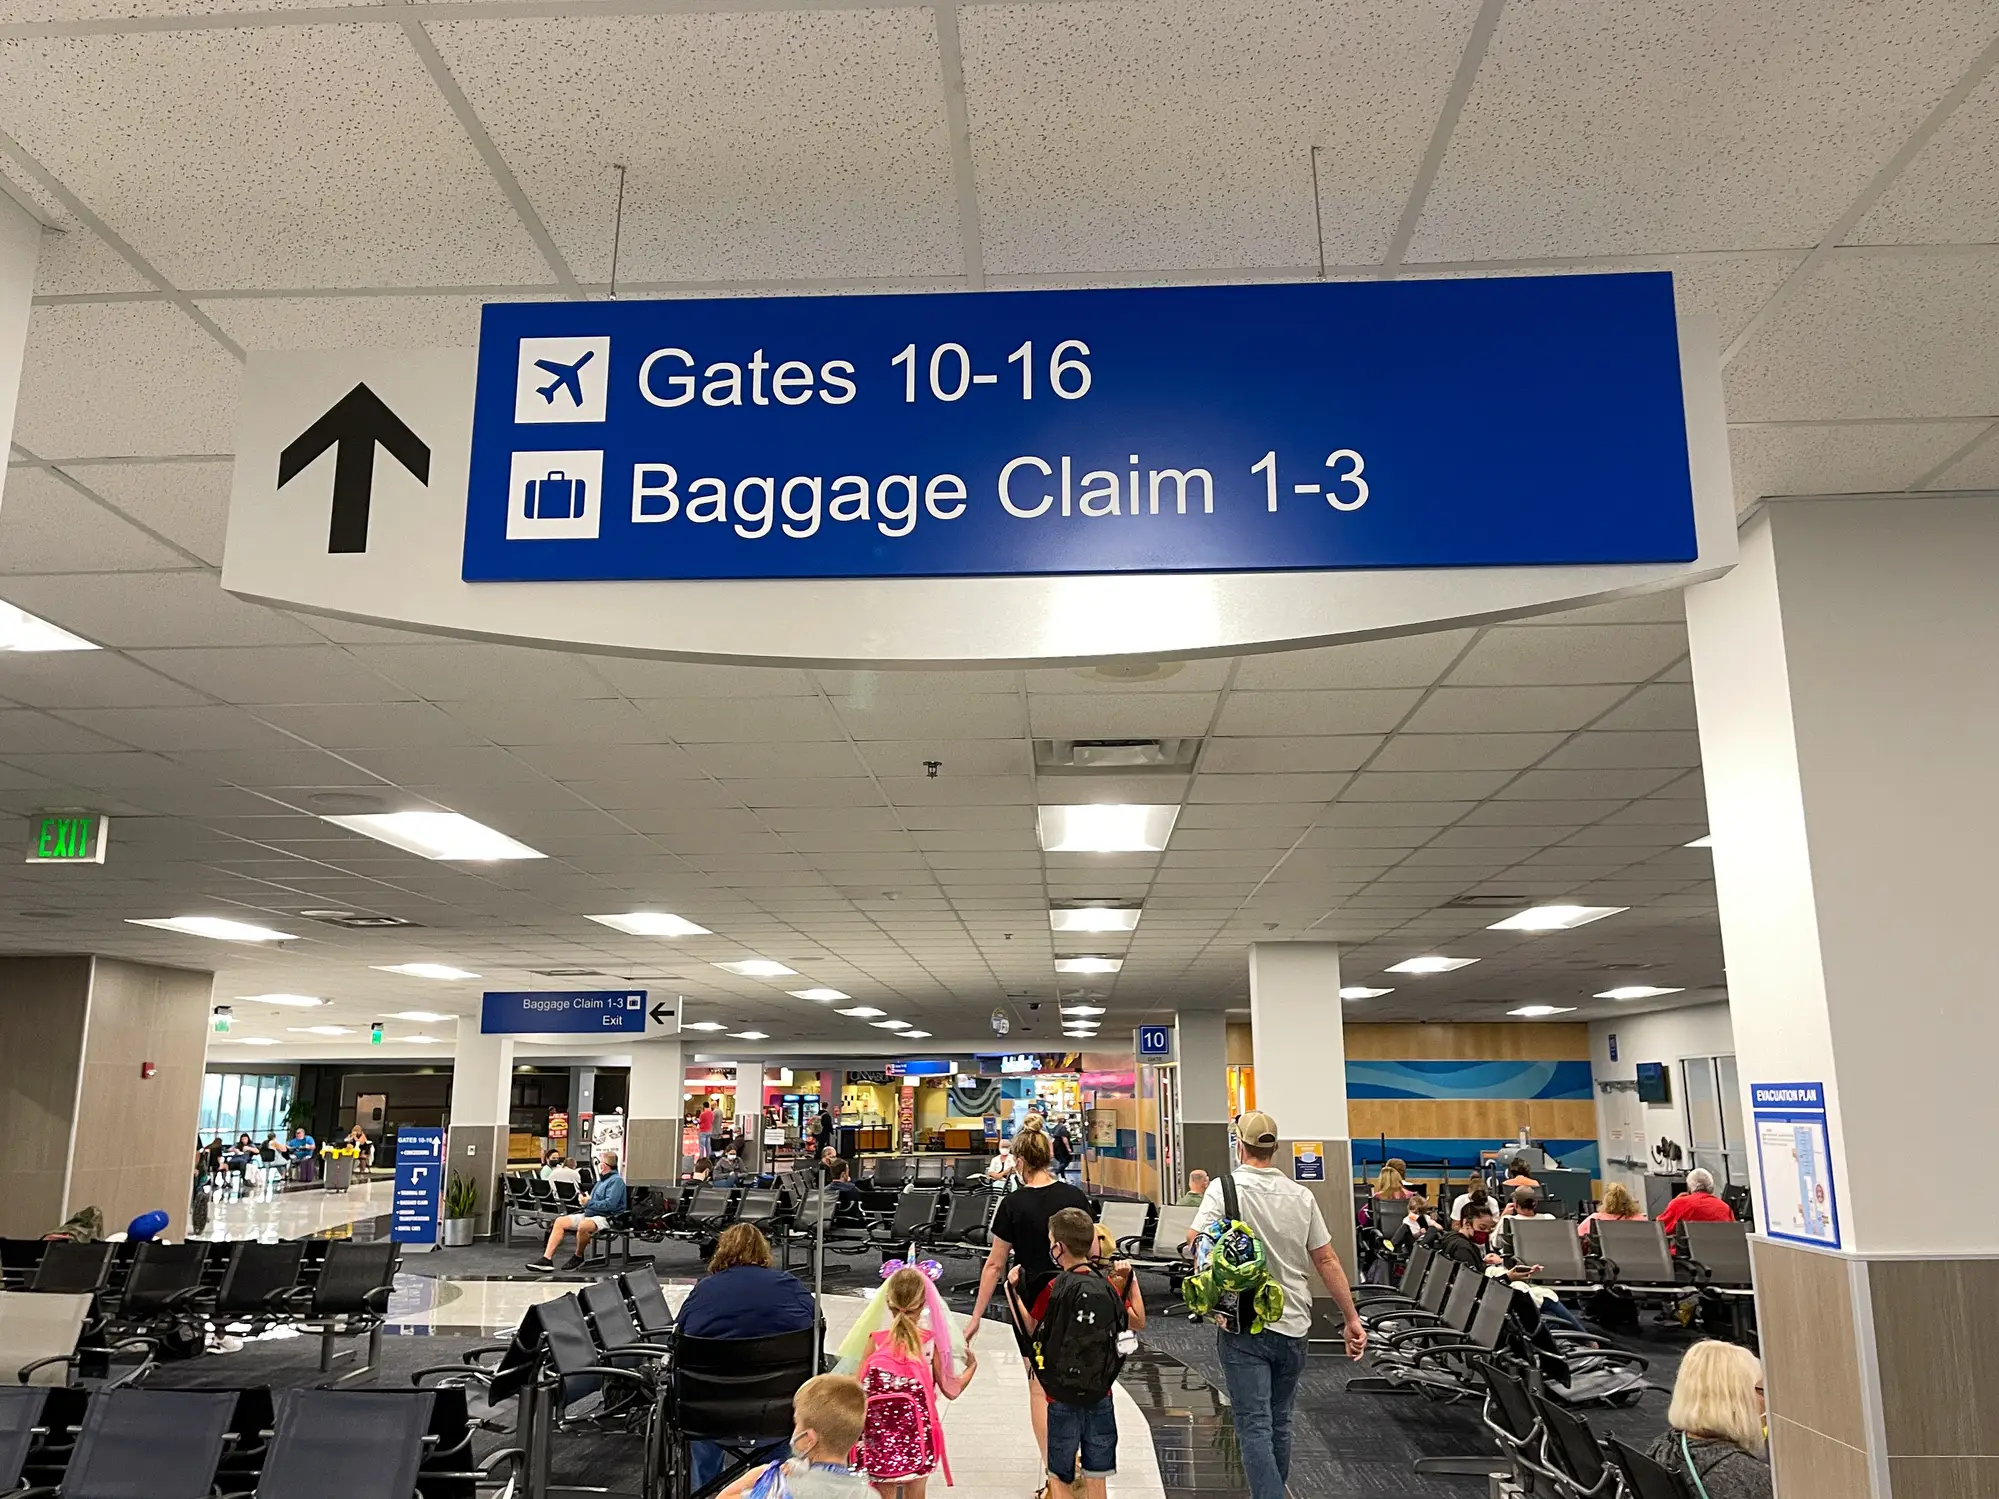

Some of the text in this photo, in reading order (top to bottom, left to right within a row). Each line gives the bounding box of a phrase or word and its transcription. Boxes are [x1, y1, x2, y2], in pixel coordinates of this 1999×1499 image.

[638, 339, 1092, 408] Gates 10-16
[631, 448, 1370, 539] Baggage Claim 1-3
[38, 818, 92, 857] EXIT
[523, 996, 624, 1012] Baggage Claim 1-3
[602, 1015, 623, 1026] Exit
[1144, 1031, 1165, 1048] 10
[1756, 1089, 1817, 1102] EVACUATION PLAN
[397, 1136, 417, 1144] GATES
